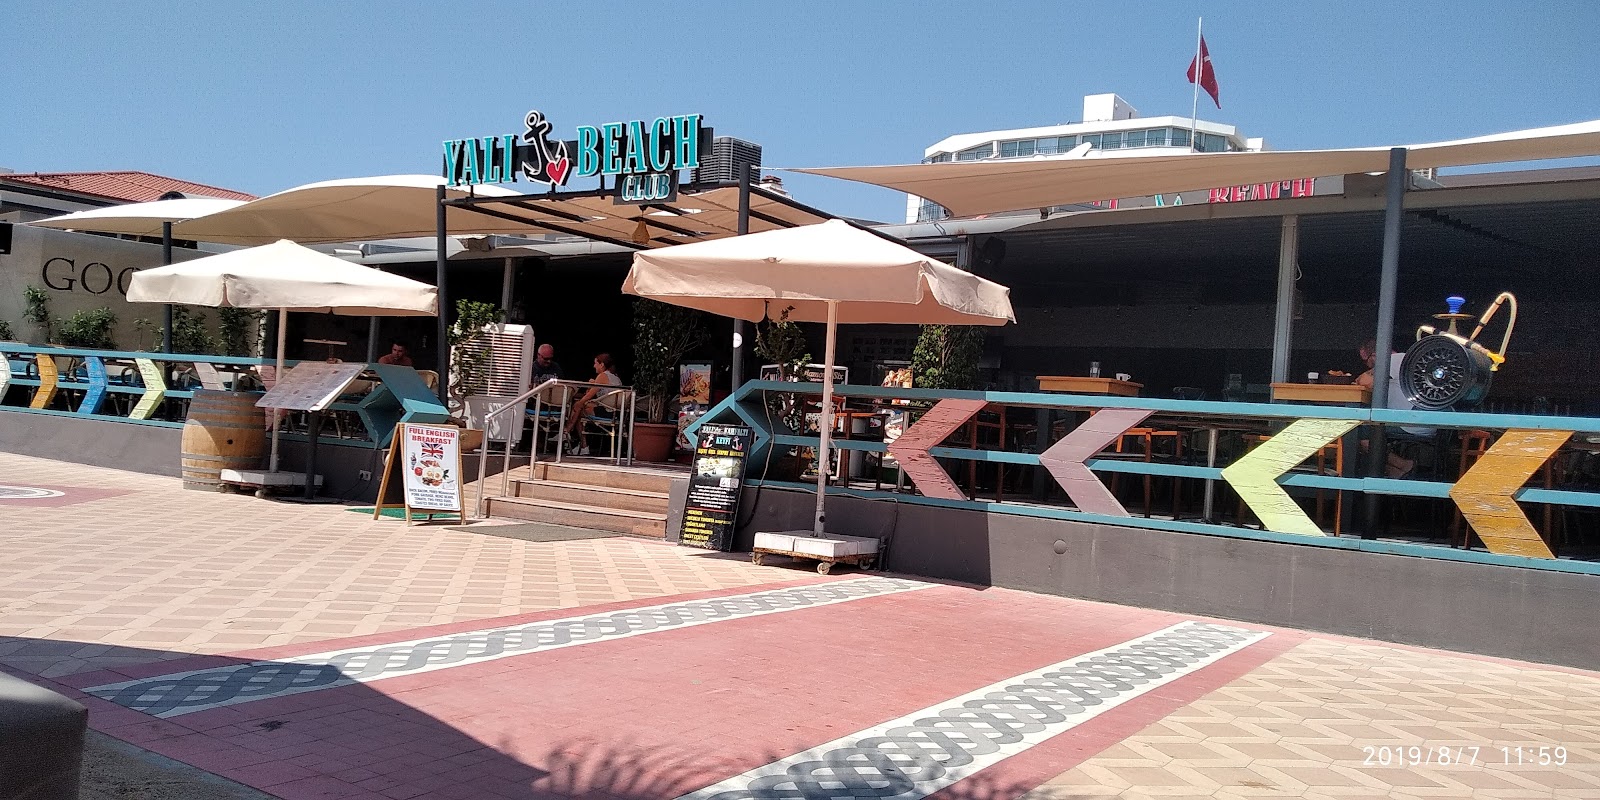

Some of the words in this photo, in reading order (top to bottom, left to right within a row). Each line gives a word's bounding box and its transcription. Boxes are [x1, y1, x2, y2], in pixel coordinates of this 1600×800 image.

[443, 134, 514, 187] YALI
[576, 114, 701, 177] BEACH
[621, 174, 670, 201] CLUB
[409, 427, 424, 435] FULL
[426, 429, 455, 438] ENGLISH
[412, 435, 452, 445] BREAKFAST
